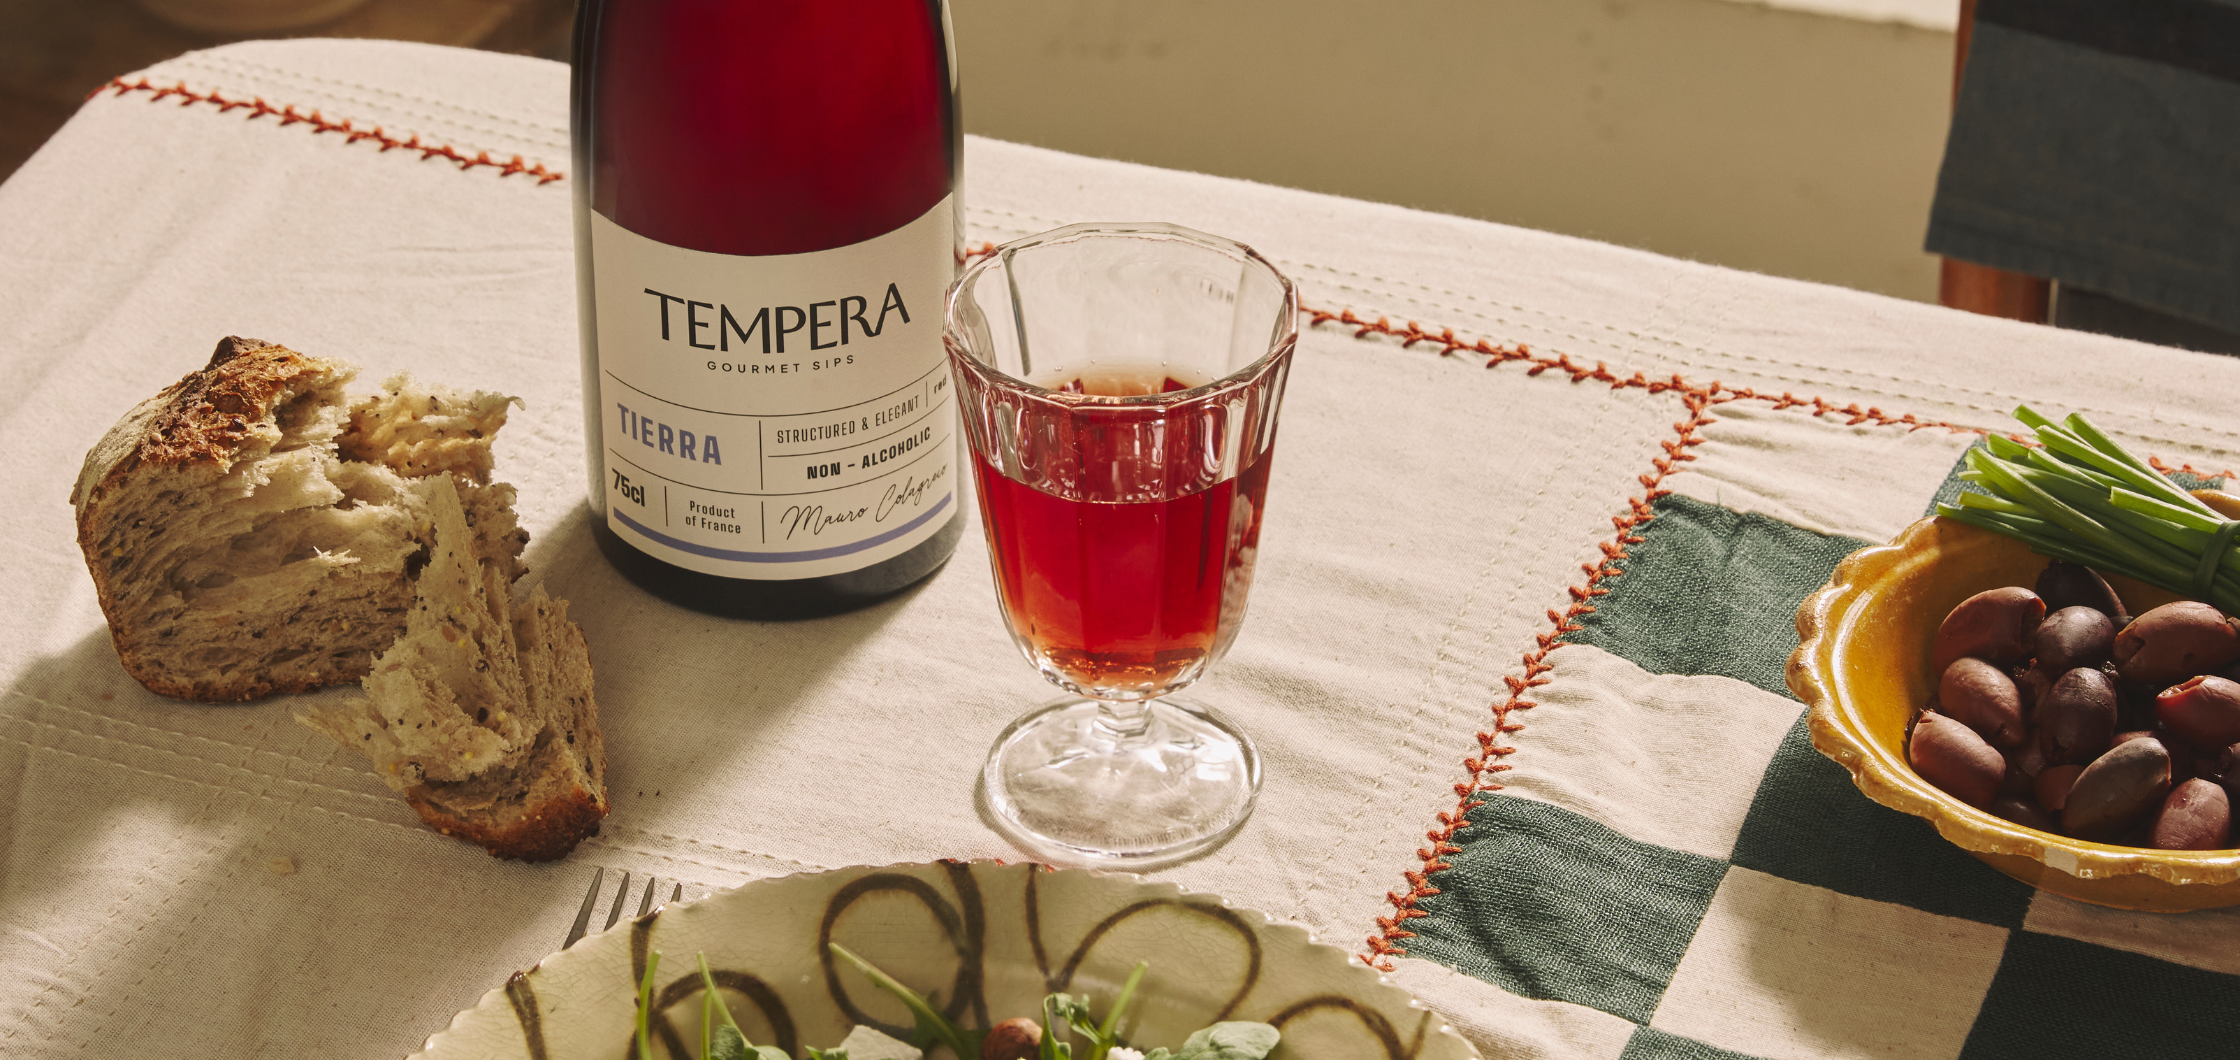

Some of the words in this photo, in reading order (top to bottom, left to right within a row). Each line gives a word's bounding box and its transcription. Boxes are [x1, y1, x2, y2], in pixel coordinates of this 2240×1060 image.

[644, 282, 911, 354] TEMPERA
[707, 360, 800, 374] GOURMET
[812, 355, 854, 371] SIPS
[933, 373, 947, 395] red
[616, 402, 722, 466] TIERRA
[777, 420, 856, 444] STRUCTURED
[862, 416, 870, 431] &
[875, 394, 920, 427] ELEGANT
[806, 461, 841, 480] NON
[861, 426, 931, 470] ALCOHOLIC
[611, 467, 646, 508] 75cl
[685, 515, 697, 527] of
[700, 516, 742, 535] France
[689, 499, 736, 519] Product
[780, 504, 869, 541] Mauro
